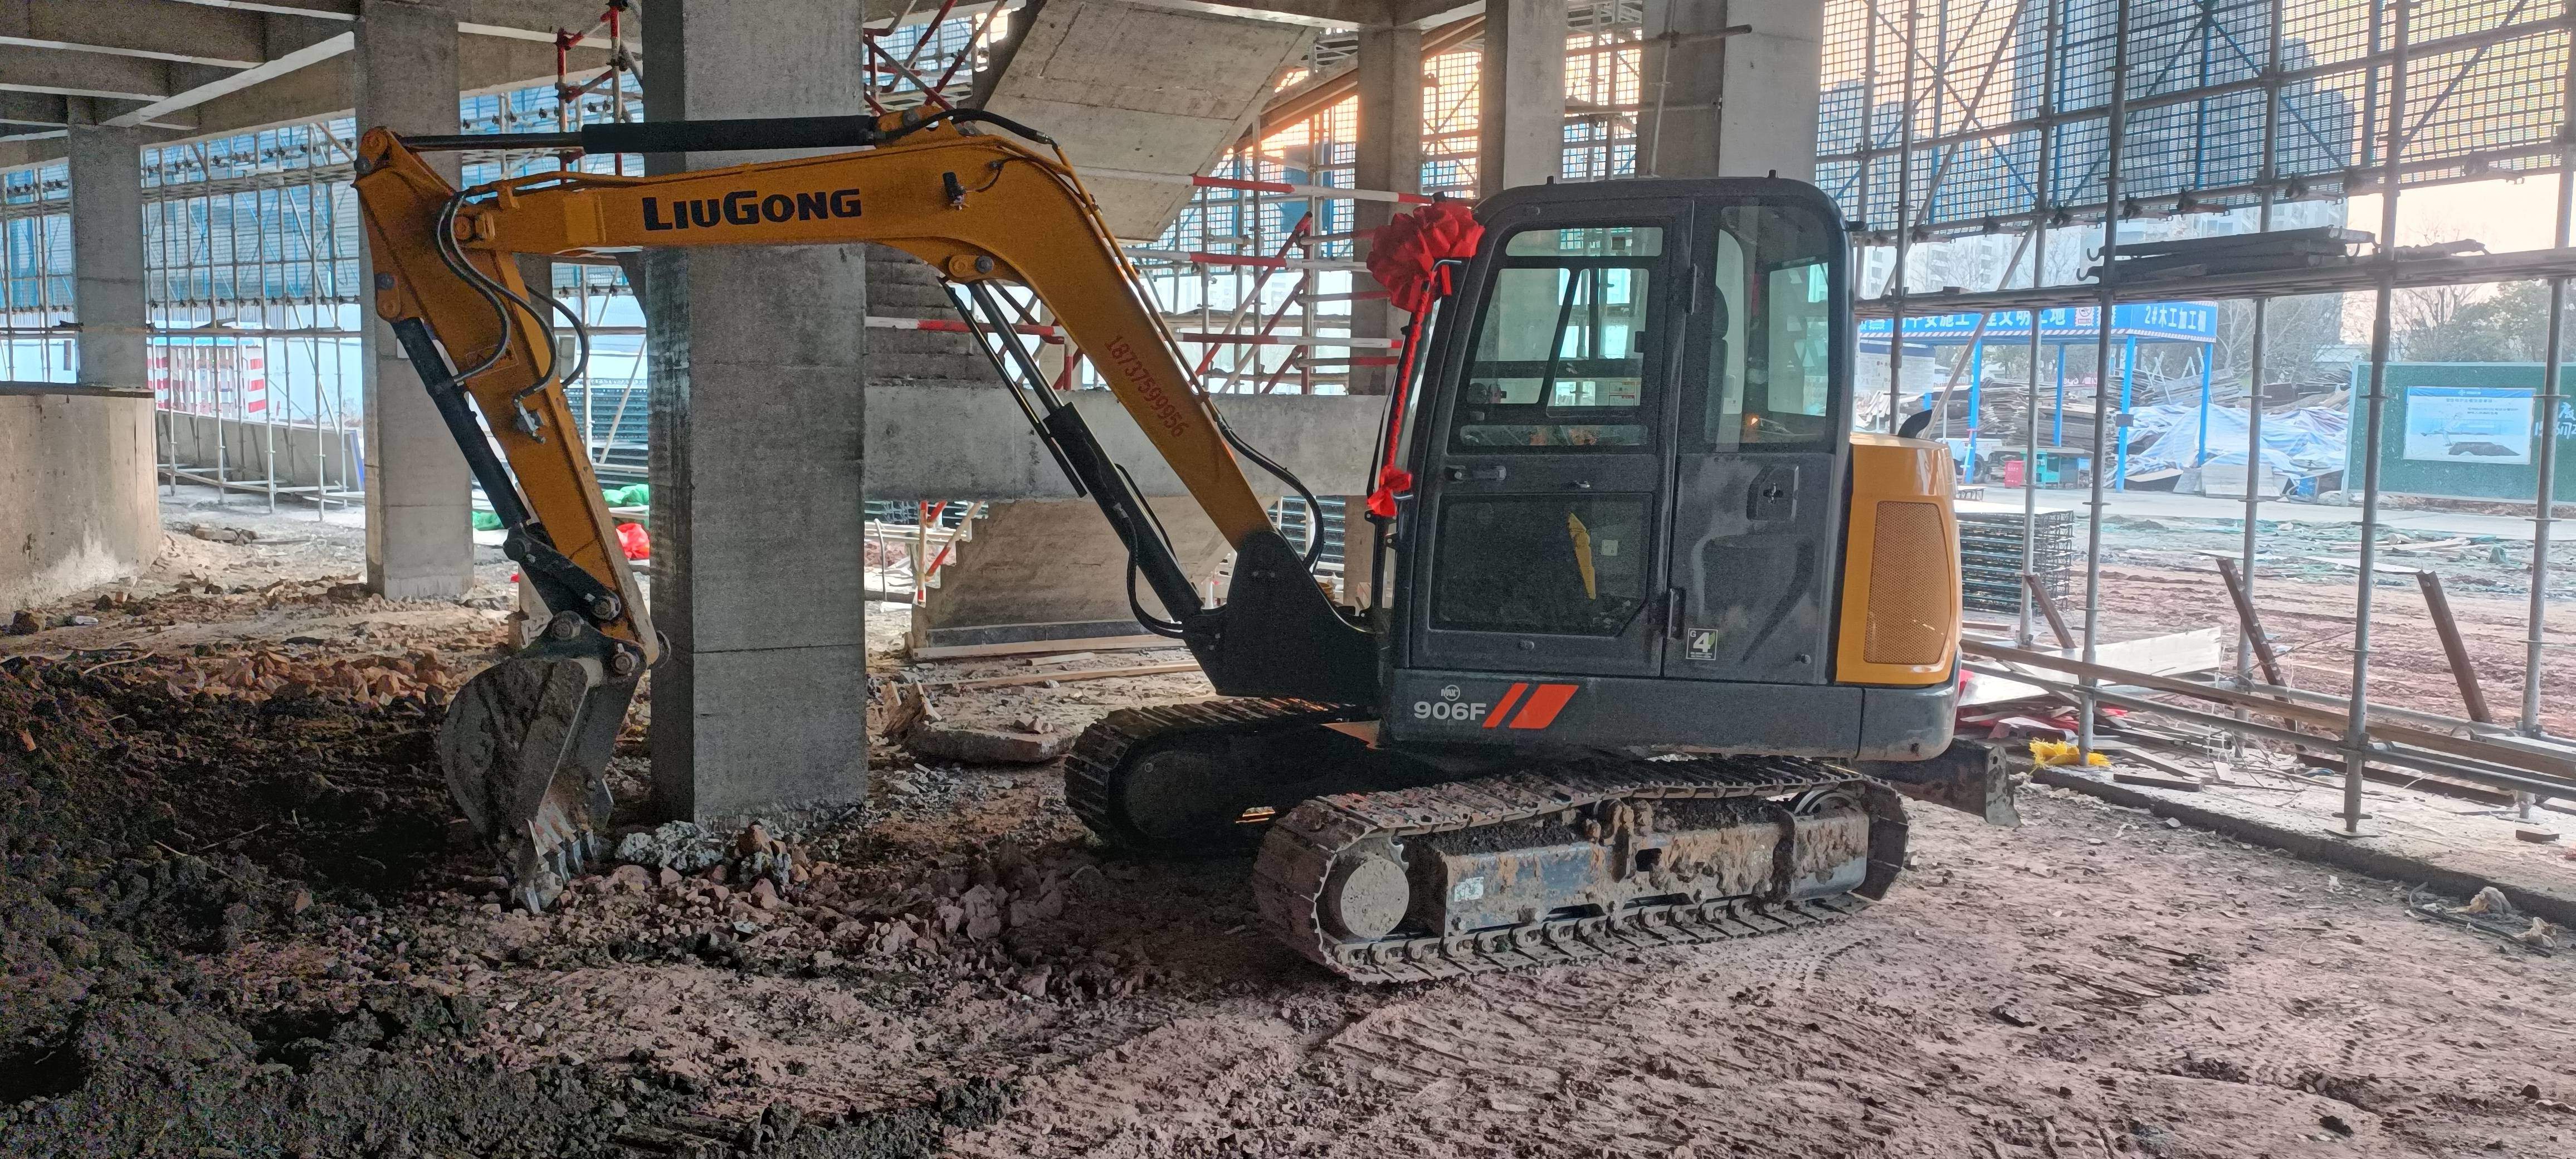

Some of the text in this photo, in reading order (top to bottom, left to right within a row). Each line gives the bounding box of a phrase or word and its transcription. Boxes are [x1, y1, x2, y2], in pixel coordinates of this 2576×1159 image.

[1104, 334, 1189, 437] 18737599956
[1693, 632, 1711, 652] 4
[1413, 701, 1487, 720] 906F
